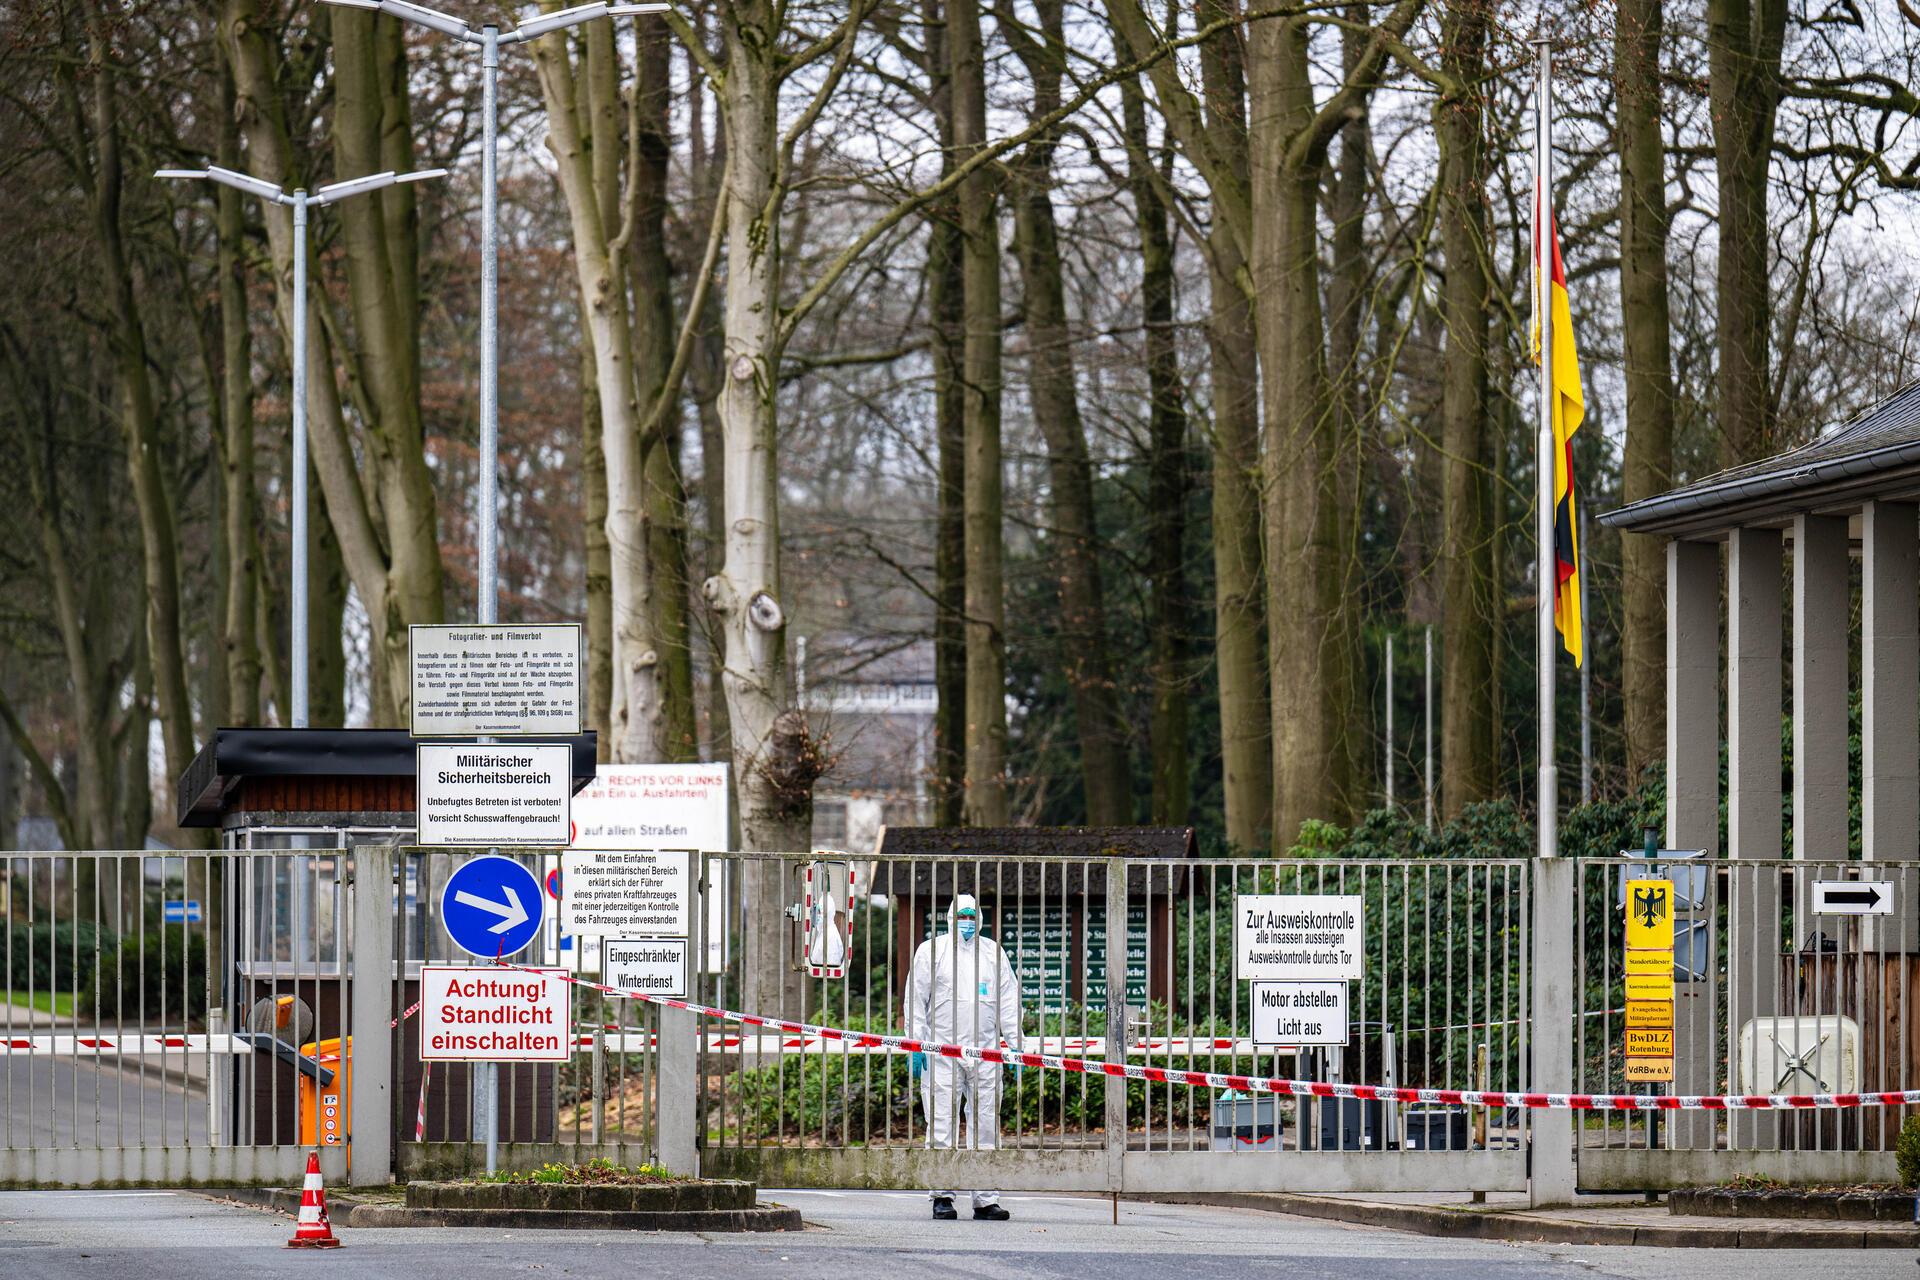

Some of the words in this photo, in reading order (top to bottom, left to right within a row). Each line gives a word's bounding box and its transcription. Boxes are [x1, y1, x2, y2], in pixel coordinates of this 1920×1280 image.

[449, 633, 487, 642] Fotografier-
[507, 632, 541, 640] Filmverbot
[457, 755, 533, 767] Militärischer
[438, 772, 550, 784] Sicherheitsbereich
[609, 776, 655, 786] RECHTS
[660, 776, 684, 785] VOR
[688, 775, 722, 786] LINKS
[592, 790, 605, 798] an
[608, 788, 626, 798] Ein
[630, 790, 640, 798] u.
[643, 788, 708, 799] Ausfahrten)
[428, 798, 473, 807] Unbefugtes
[512, 797, 521, 806] ist
[524, 798, 561, 806] verboten!
[429, 814, 461, 822] Vorsicht
[464, 814, 560, 824] Schusswaffengebrauch!
[584, 824, 603, 836] auf
[608, 826, 635, 836] allen
[640, 824, 687, 836] Straßen
[596, 854, 606, 863] Mit
[608, 854, 622, 863] dem
[624, 854, 656, 863] Einfahren
[574, 866, 580, 874] in
[581, 865, 604, 874] diesen
[606, 865, 650, 875] militärischen
[652, 866, 677, 875] Bereich
[588, 878, 610, 886] erklärt
[612, 878, 626, 887] sich
[628, 878, 639, 887] der
[641, 878, 663, 887] Führer
[574, 890, 592, 898] eines
[594, 890, 621, 900] privaten
[624, 890, 677, 901] Kraftfahrzeuges
[572, 902, 582, 910] mit
[584, 902, 602, 910] einer
[603, 902, 646, 913] jederzeitigen
[648, 901, 679, 911] Kontrolle
[575, 915, 586, 924] des
[589, 914, 627, 925] Fahrzeuges
[629, 915, 677, 924] einverstanden
[1247, 910, 1264, 929] Zur
[1267, 910, 1354, 930] Ausweiskontrolle
[1256, 930, 1268, 944] alle
[1271, 930, 1303, 944] Insassen
[1305, 930, 1344, 947] aussteigen
[610, 948, 680, 965] Eingeschränkter
[1248, 950, 1311, 964] Ausweiskontrolle
[1313, 950, 1338, 964] durchs
[1340, 950, 1352, 964] Tor
[618, 974, 672, 988] Winterdienst
[446, 979, 546, 1002] Achtung!
[1262, 990, 1290, 1007] Motor
[1294, 990, 1337, 1007] abstellen
[441, 1005, 552, 1024] Standlicht
[1278, 1018, 1301, 1035] Licht
[1305, 1023, 1321, 1035] aus
[432, 1031, 558, 1050] einschalten
[1630, 1033, 1669, 1042] BwDLZ
[1630, 1046, 1670, 1054] Rotenburg
